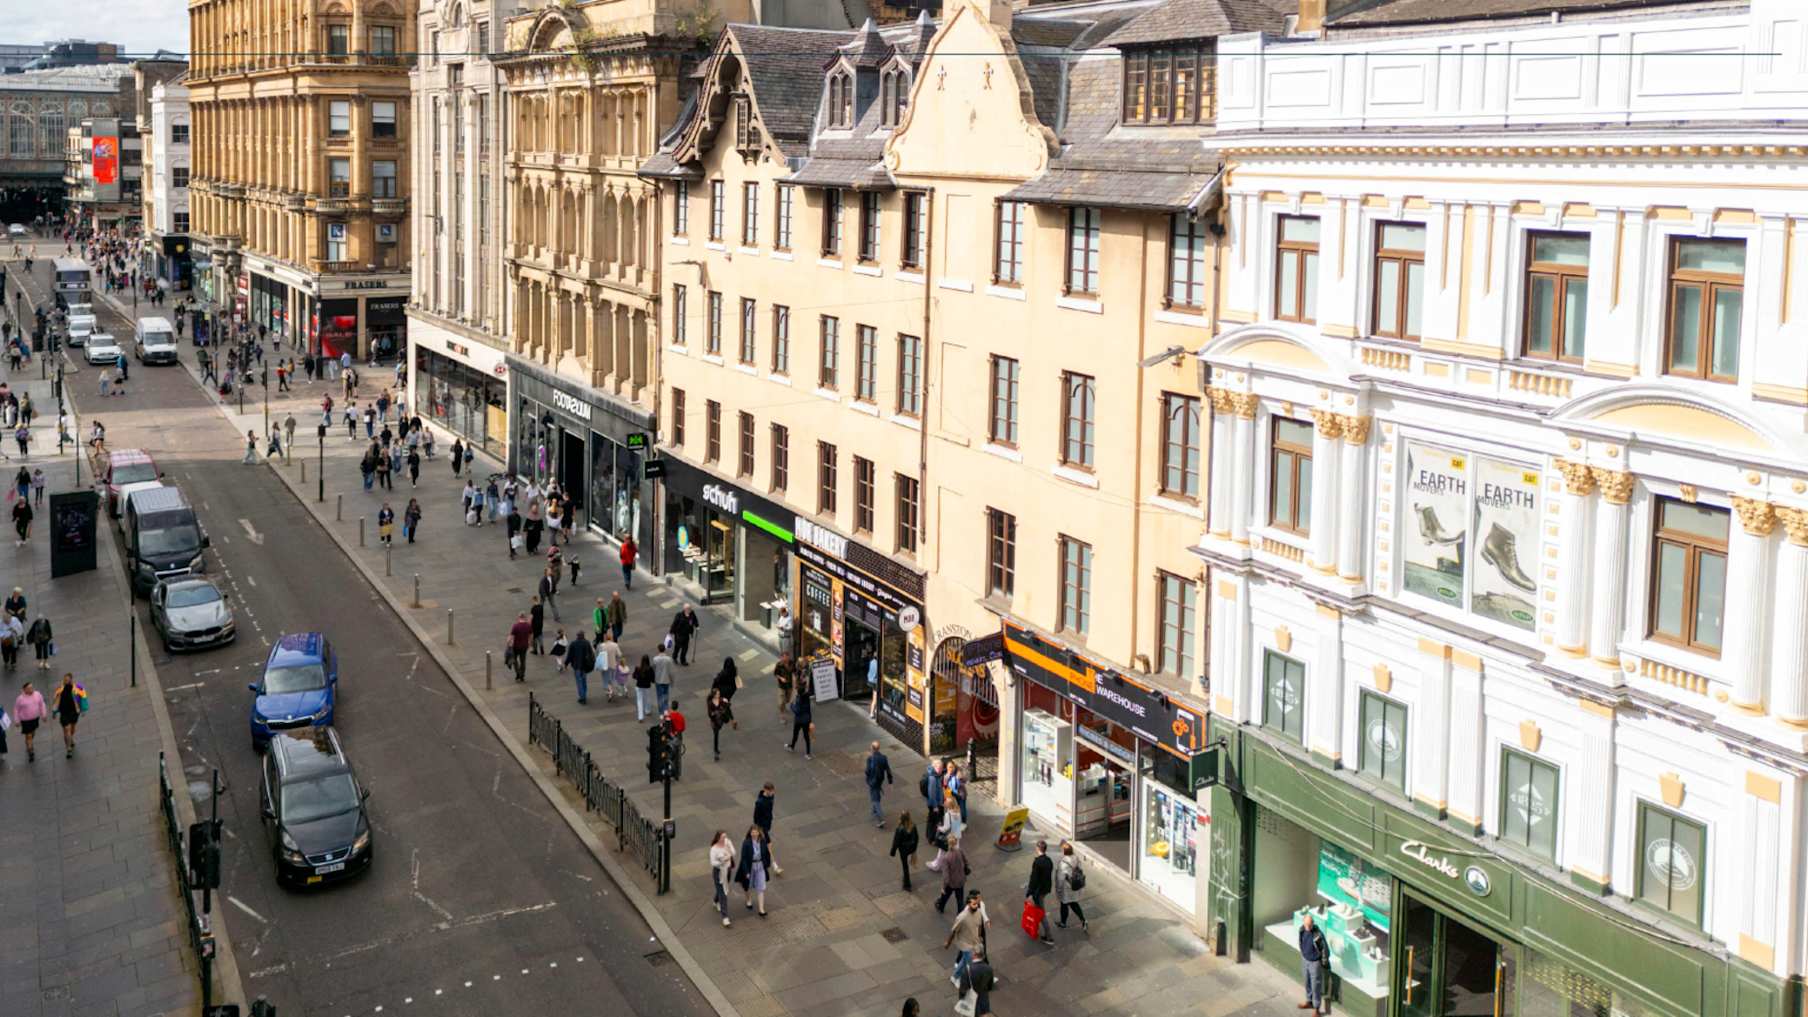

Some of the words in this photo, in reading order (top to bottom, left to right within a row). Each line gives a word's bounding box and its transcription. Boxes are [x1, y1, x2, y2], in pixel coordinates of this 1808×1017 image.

[344, 279, 388, 289] FRASERS
[1419, 470, 1466, 495] EARTH
[702, 483, 738, 515] schuh
[1484, 483, 1534, 509] EARTH
[806, 584, 830, 607] COFFEE
[1096, 685, 1147, 717] WAREHOUSE
[1401, 839, 1460, 879] Clarks
